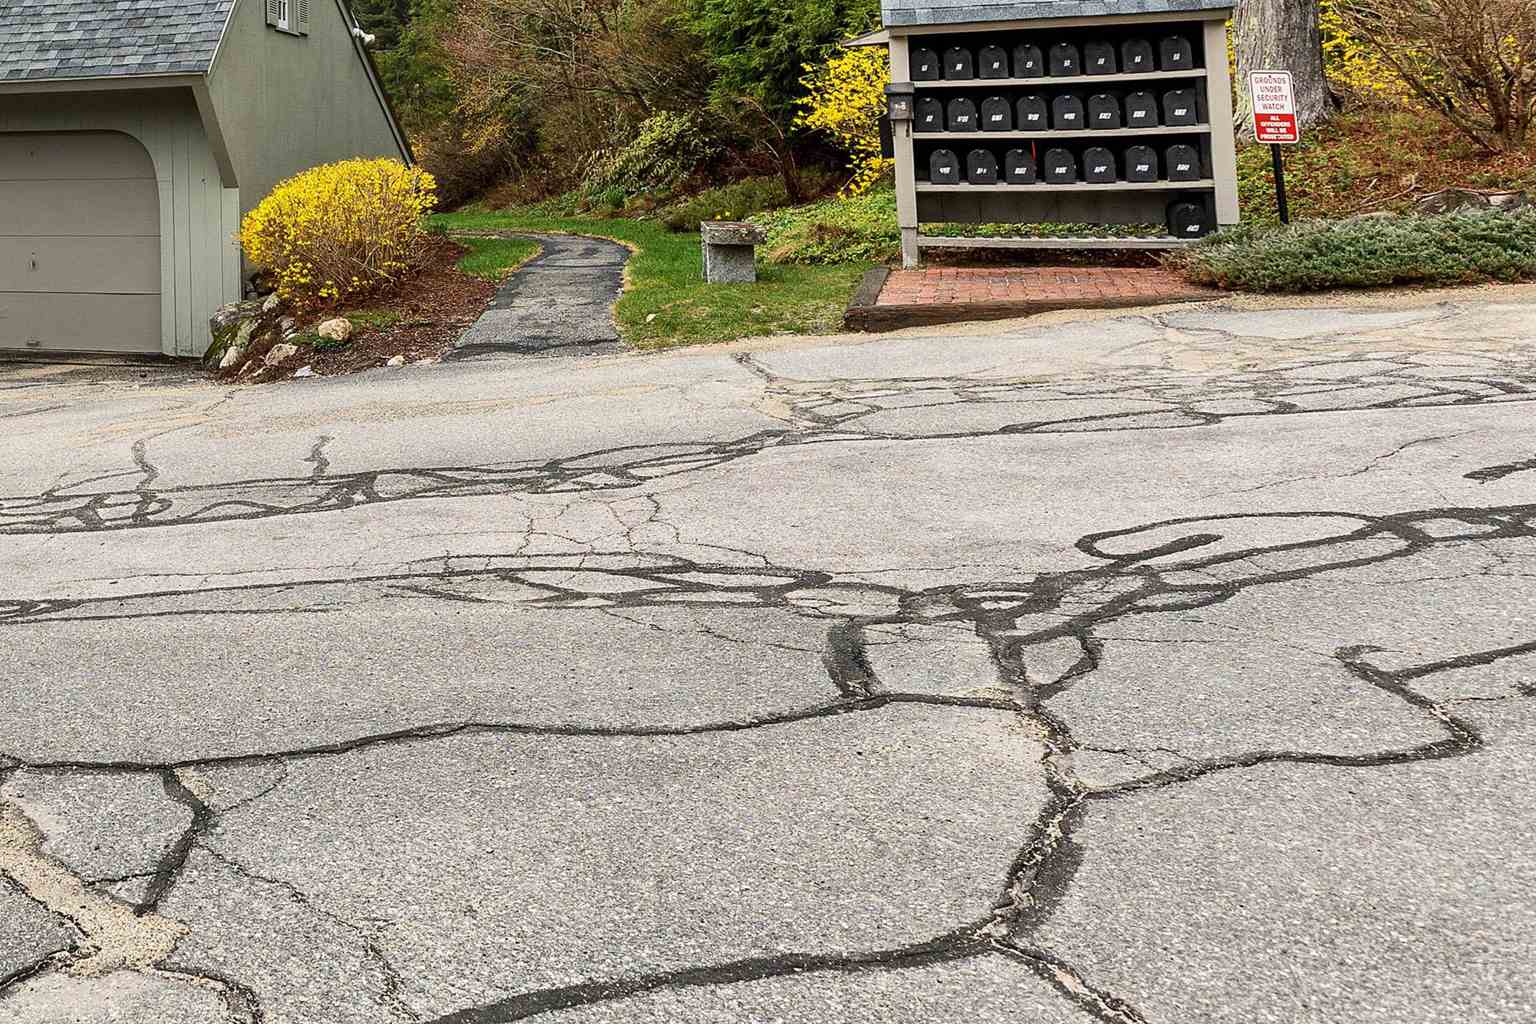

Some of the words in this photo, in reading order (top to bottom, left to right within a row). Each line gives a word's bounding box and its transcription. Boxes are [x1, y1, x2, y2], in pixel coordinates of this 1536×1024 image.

[1254, 77, 1287, 85] GROUNDS
[1256, 94, 1288, 102] SECURITY
[1262, 103, 1285, 111] WATCH
